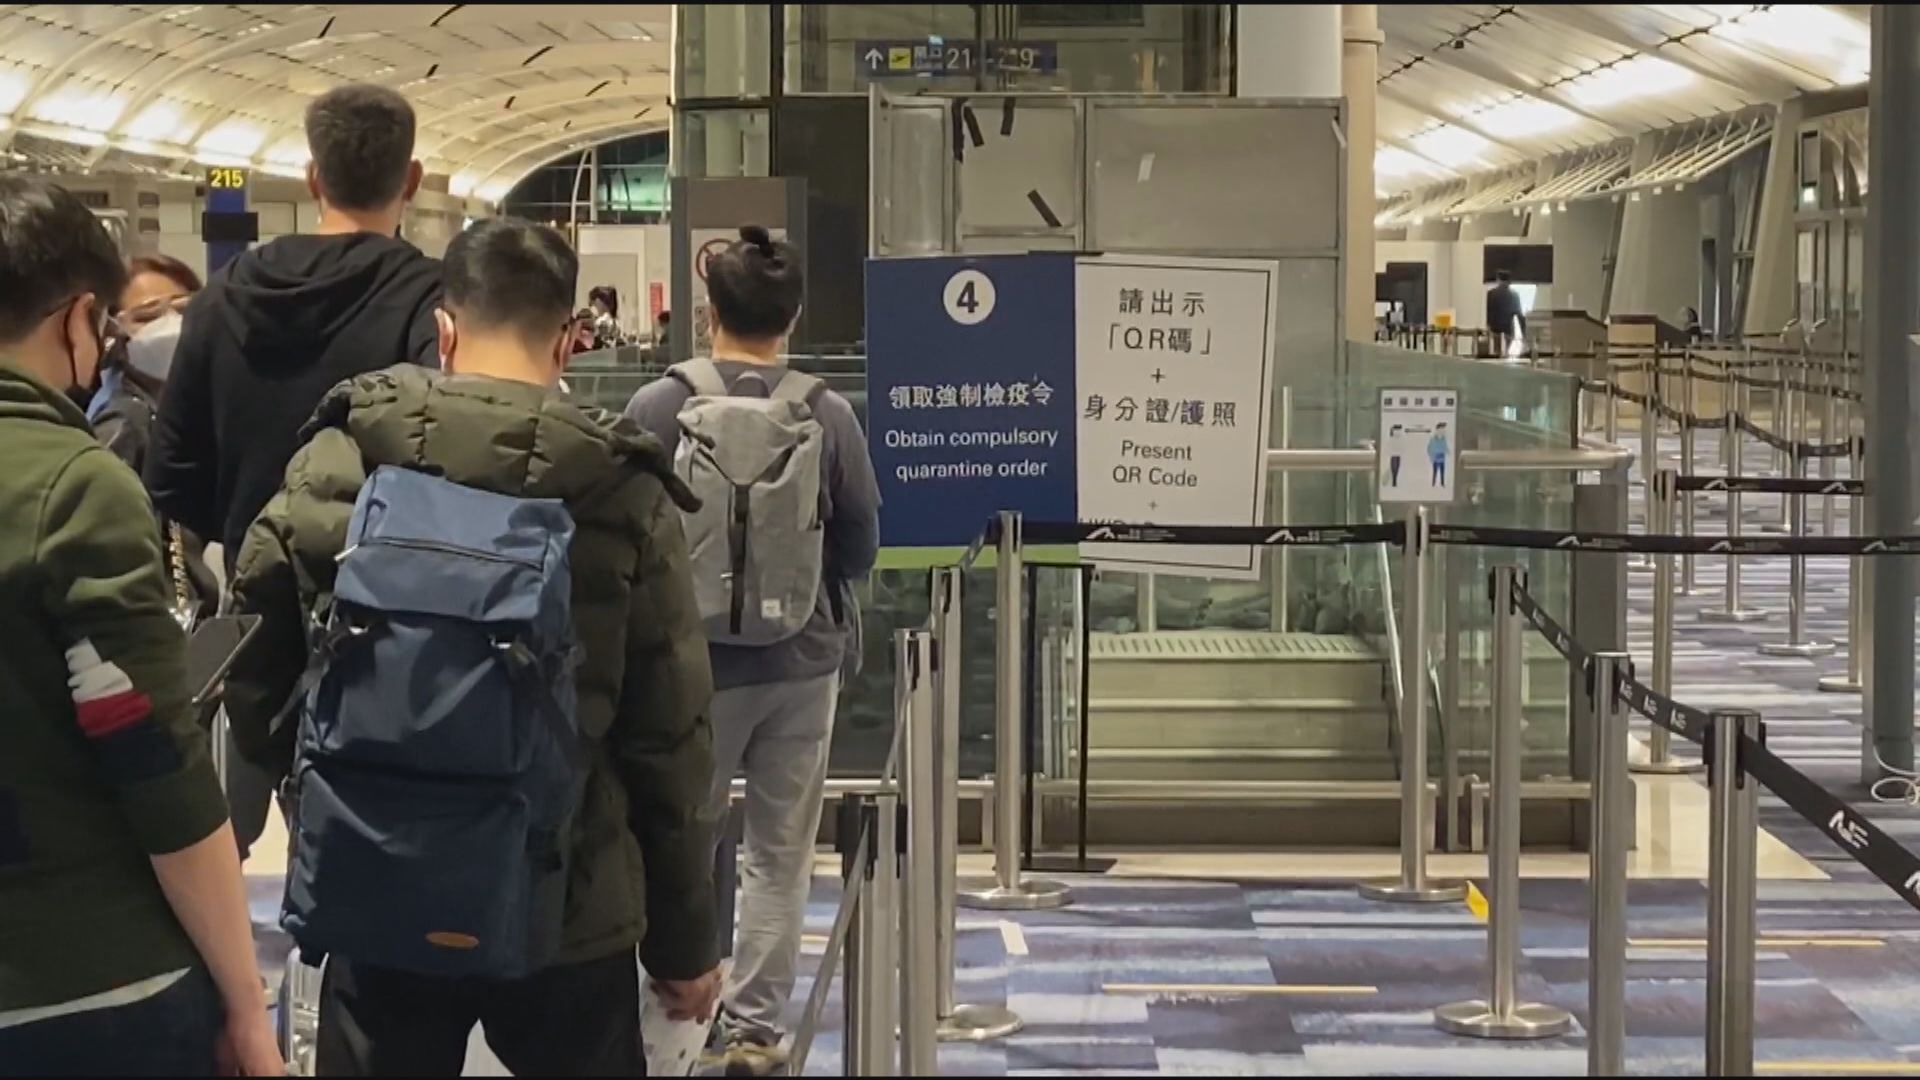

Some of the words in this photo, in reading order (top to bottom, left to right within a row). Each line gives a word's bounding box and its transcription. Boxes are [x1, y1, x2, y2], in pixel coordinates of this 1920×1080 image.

[211, 168, 243, 188] 215
[956, 280, 979, 314] 4
[1118, 288, 1205, 317] 請出示
[888, 380, 1054, 409] 領取強制檢疫令
[1084, 394, 1236, 427] 身分證/護照
[885, 430, 945, 447] Obtain
[949, 427, 1058, 449] compulsory
[1121, 440, 1192, 460] Present
[896, 460, 993, 483] quarantine
[998, 459, 1048, 477] order
[1112, 465, 1142, 484] QR
[1149, 467, 1198, 487] Code
